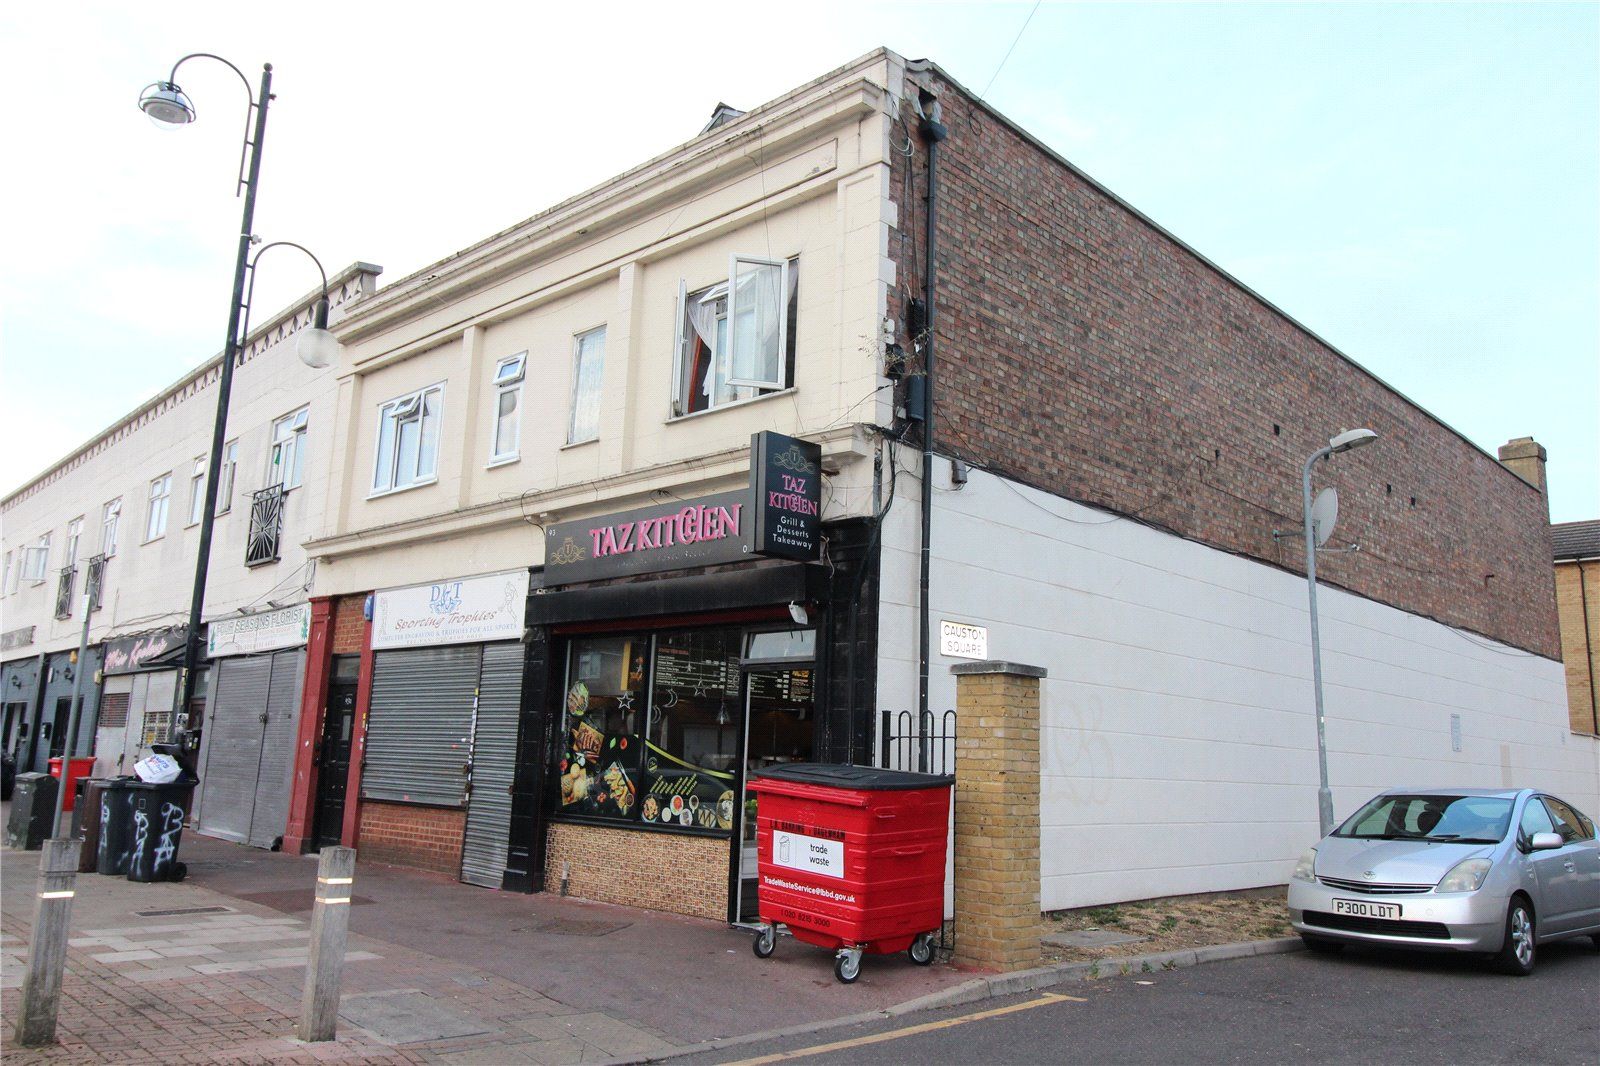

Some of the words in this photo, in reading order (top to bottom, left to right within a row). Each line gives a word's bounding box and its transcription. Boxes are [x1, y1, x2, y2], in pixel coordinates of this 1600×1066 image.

[782, 474, 806, 494] TAZ
[769, 491, 818, 516] KITCHEN
[780, 516, 798, 527] Grill
[800, 520, 805, 528] &
[589, 522, 635, 559] TAZ
[636, 504, 743, 551] KITCHEN
[777, 525, 809, 539] Desserts
[772, 533, 812, 550] Takeaway
[235, 615, 270, 634] SEASONS
[271, 608, 304, 628] FLORIST
[395, 617, 445, 631] Sporting
[448, 611, 496, 626] Trophies
[944, 624, 985, 640] CAUSTON
[947, 640, 982, 656] SQUARE
[810, 844, 828, 855] trade
[809, 856, 830, 867] waste
[763, 875, 856, 903] TradeWasteService@lbbd.gov.uk
[1337, 901, 1366, 915] P300
[1370, 904, 1394, 918] LDT
